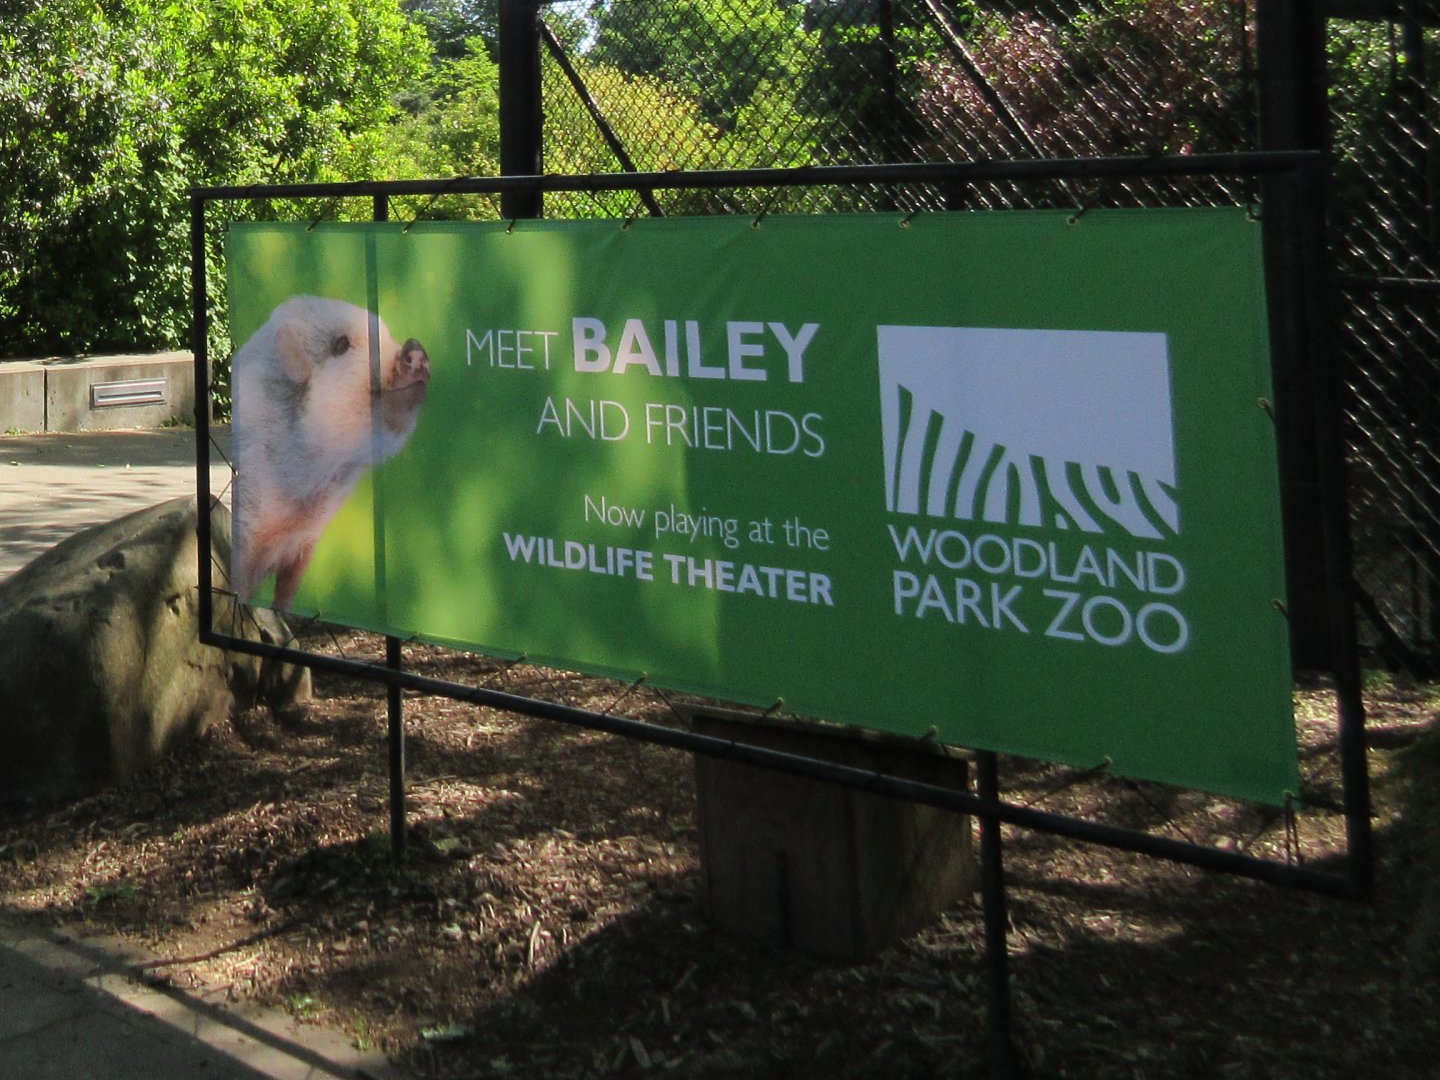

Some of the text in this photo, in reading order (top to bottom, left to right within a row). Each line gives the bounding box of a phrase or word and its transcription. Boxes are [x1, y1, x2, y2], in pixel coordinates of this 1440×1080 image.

[466, 317, 820, 383] MEET BAILEY
[536, 396, 825, 458] AND FRIENDS
[584, 494, 830, 551] Now playing at the
[503, 532, 834, 607] WILDLIFE THEATER
[887, 524, 1186, 595] WOODLAND
[892, 570, 1188, 653] PARK ZOO
